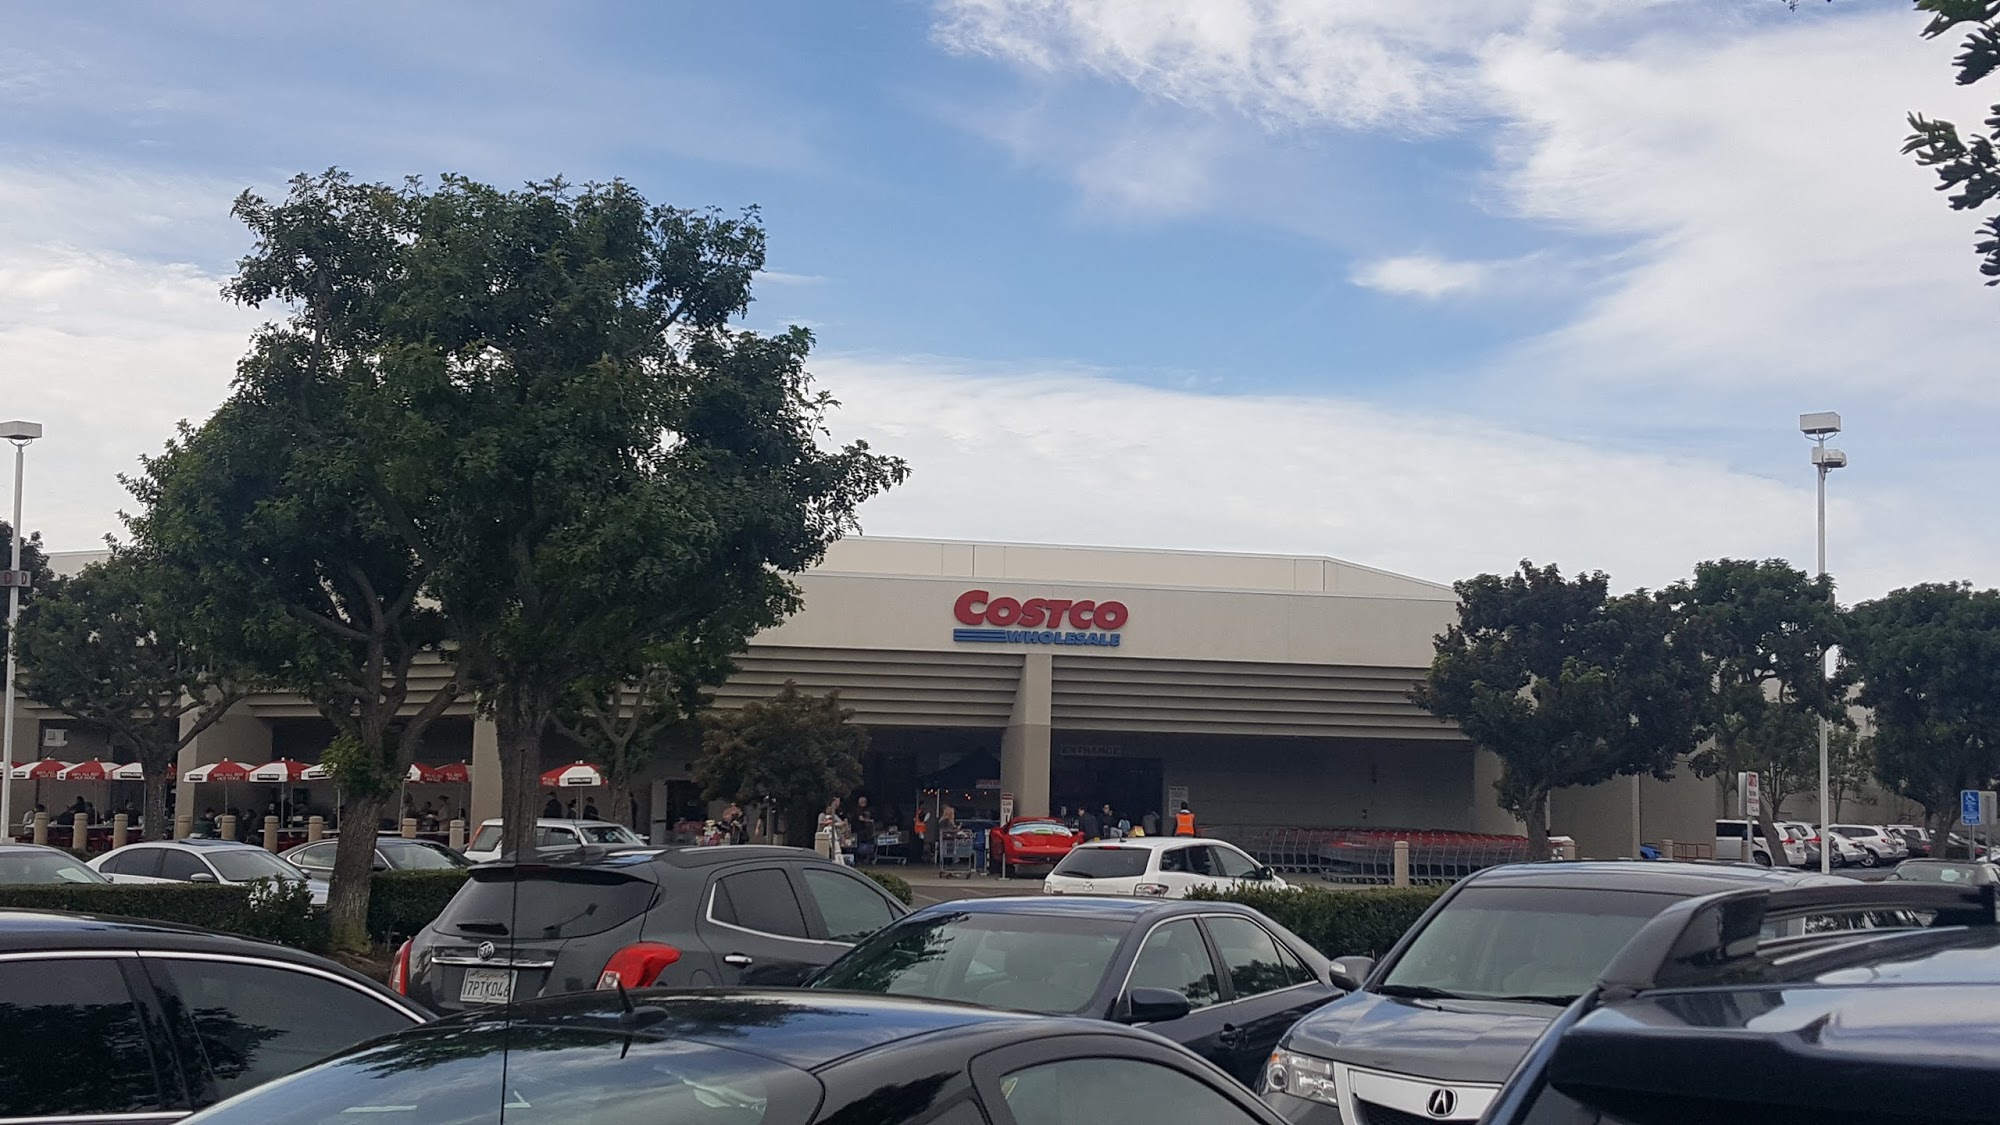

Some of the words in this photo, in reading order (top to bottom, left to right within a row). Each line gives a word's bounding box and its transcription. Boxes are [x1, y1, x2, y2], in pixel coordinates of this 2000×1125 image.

[20, 571, 27, 585] D
[953, 589, 1129, 630] COSTCO
[1006, 630, 1121, 647] WHOLESALE
